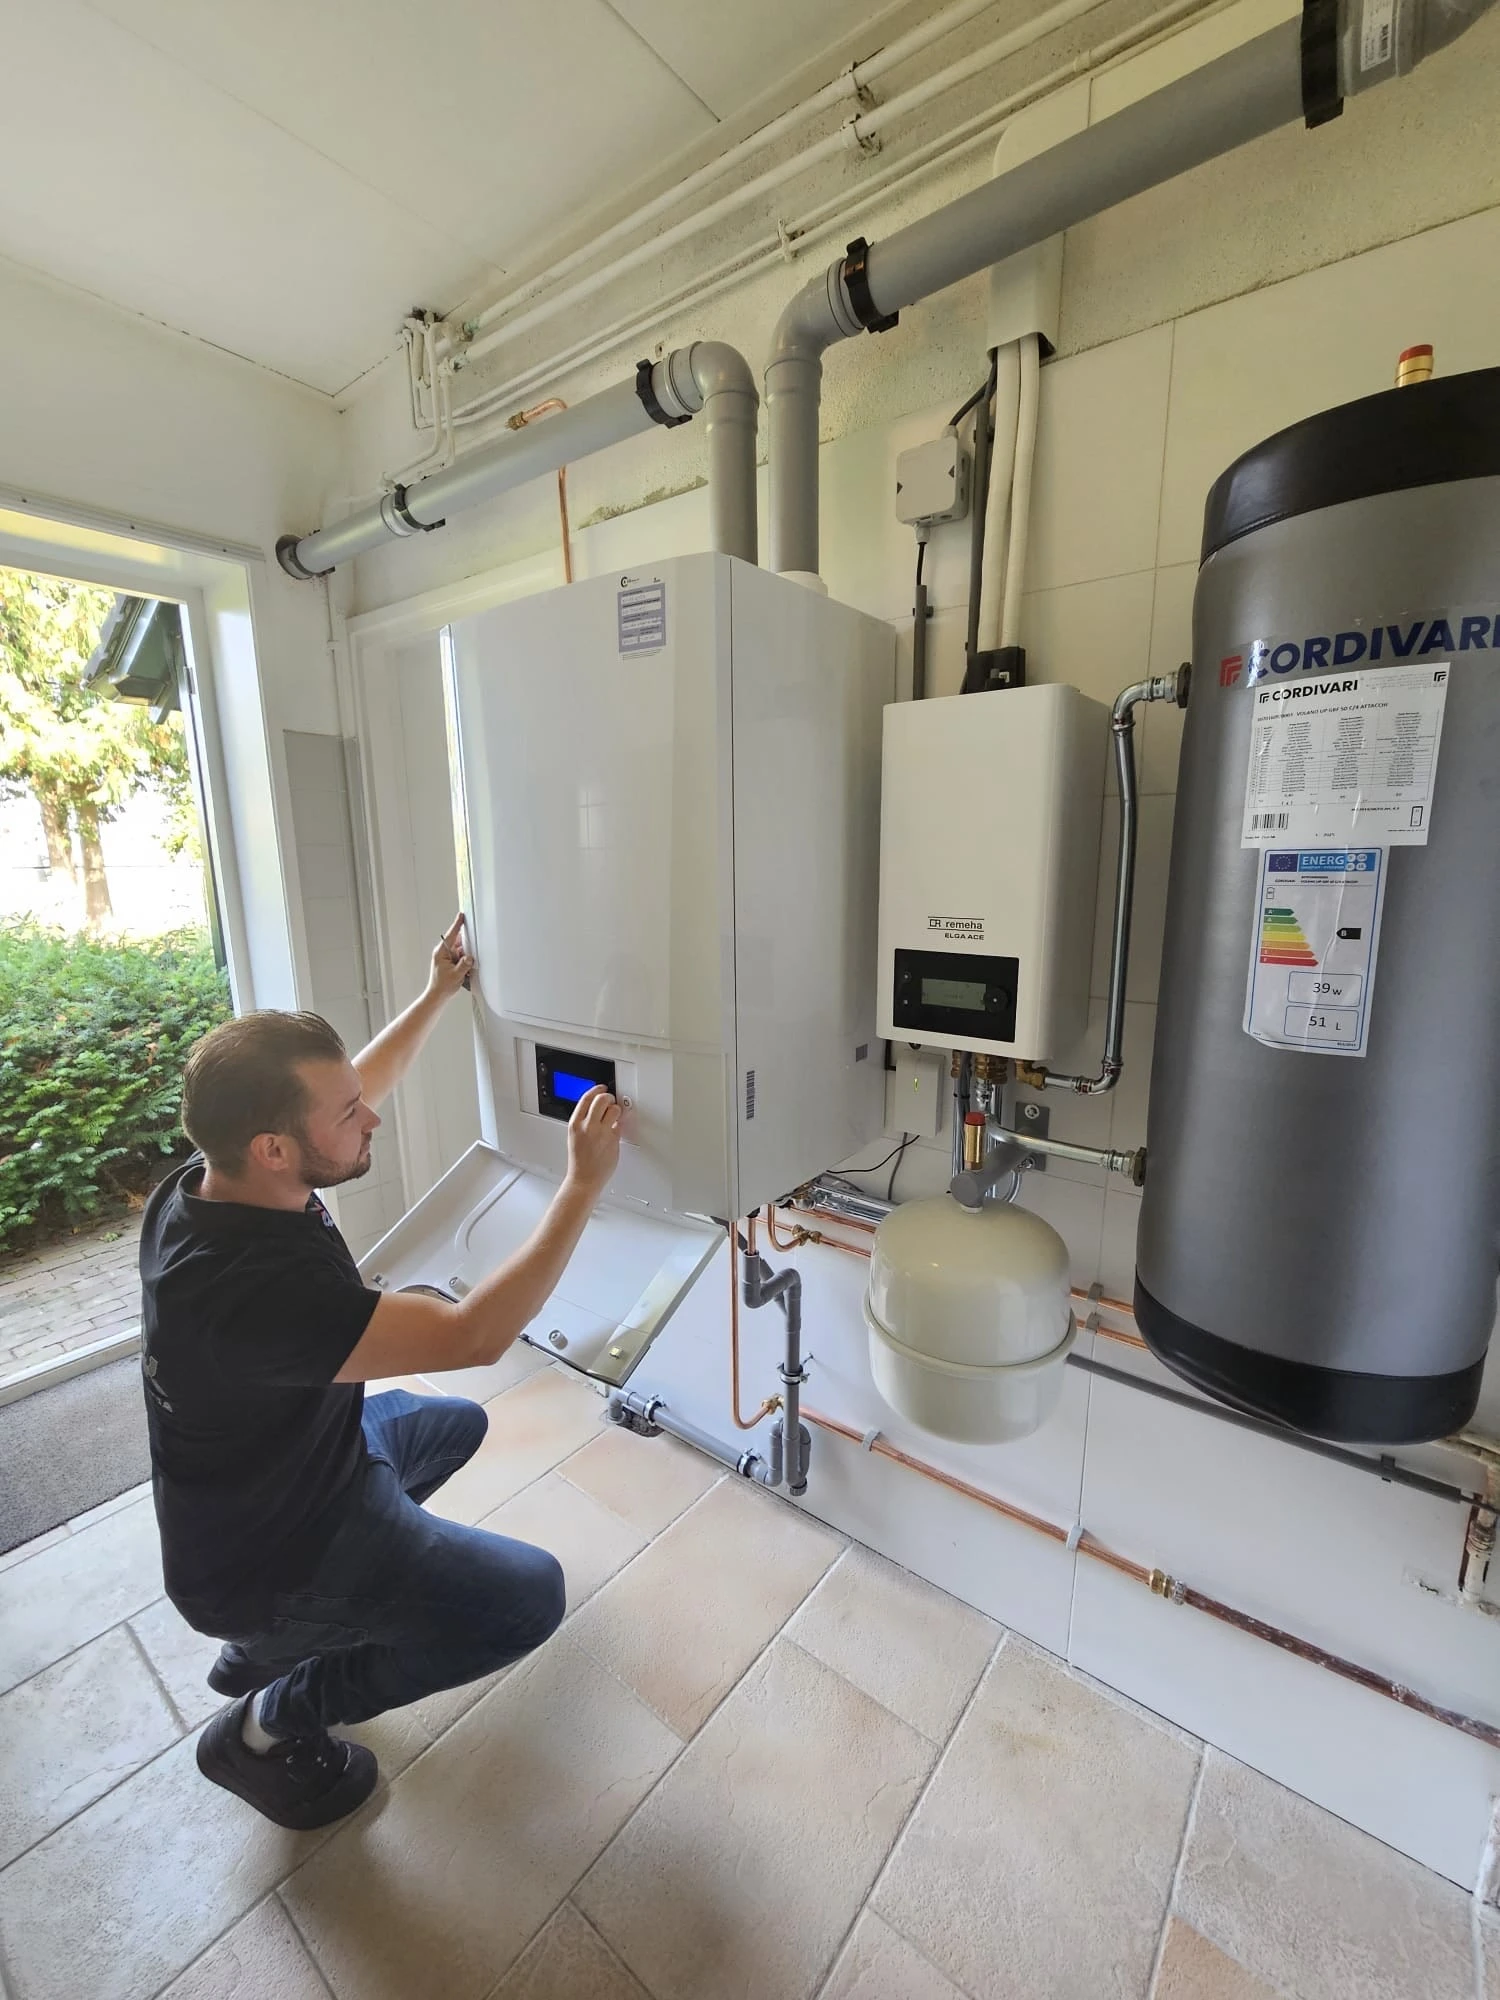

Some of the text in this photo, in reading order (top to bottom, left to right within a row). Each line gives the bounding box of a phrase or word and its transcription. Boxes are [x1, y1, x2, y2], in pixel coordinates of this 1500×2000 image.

[1247, 614, 1500, 679] CORDIVARI
[1272, 680, 1358, 701] CORDIVARI
[1302, 855, 1344, 865] ENERG
[946, 921, 982, 929] remeha
[1313, 982, 1330, 993] 39
[1309, 1015, 1342, 1030] 51 L
